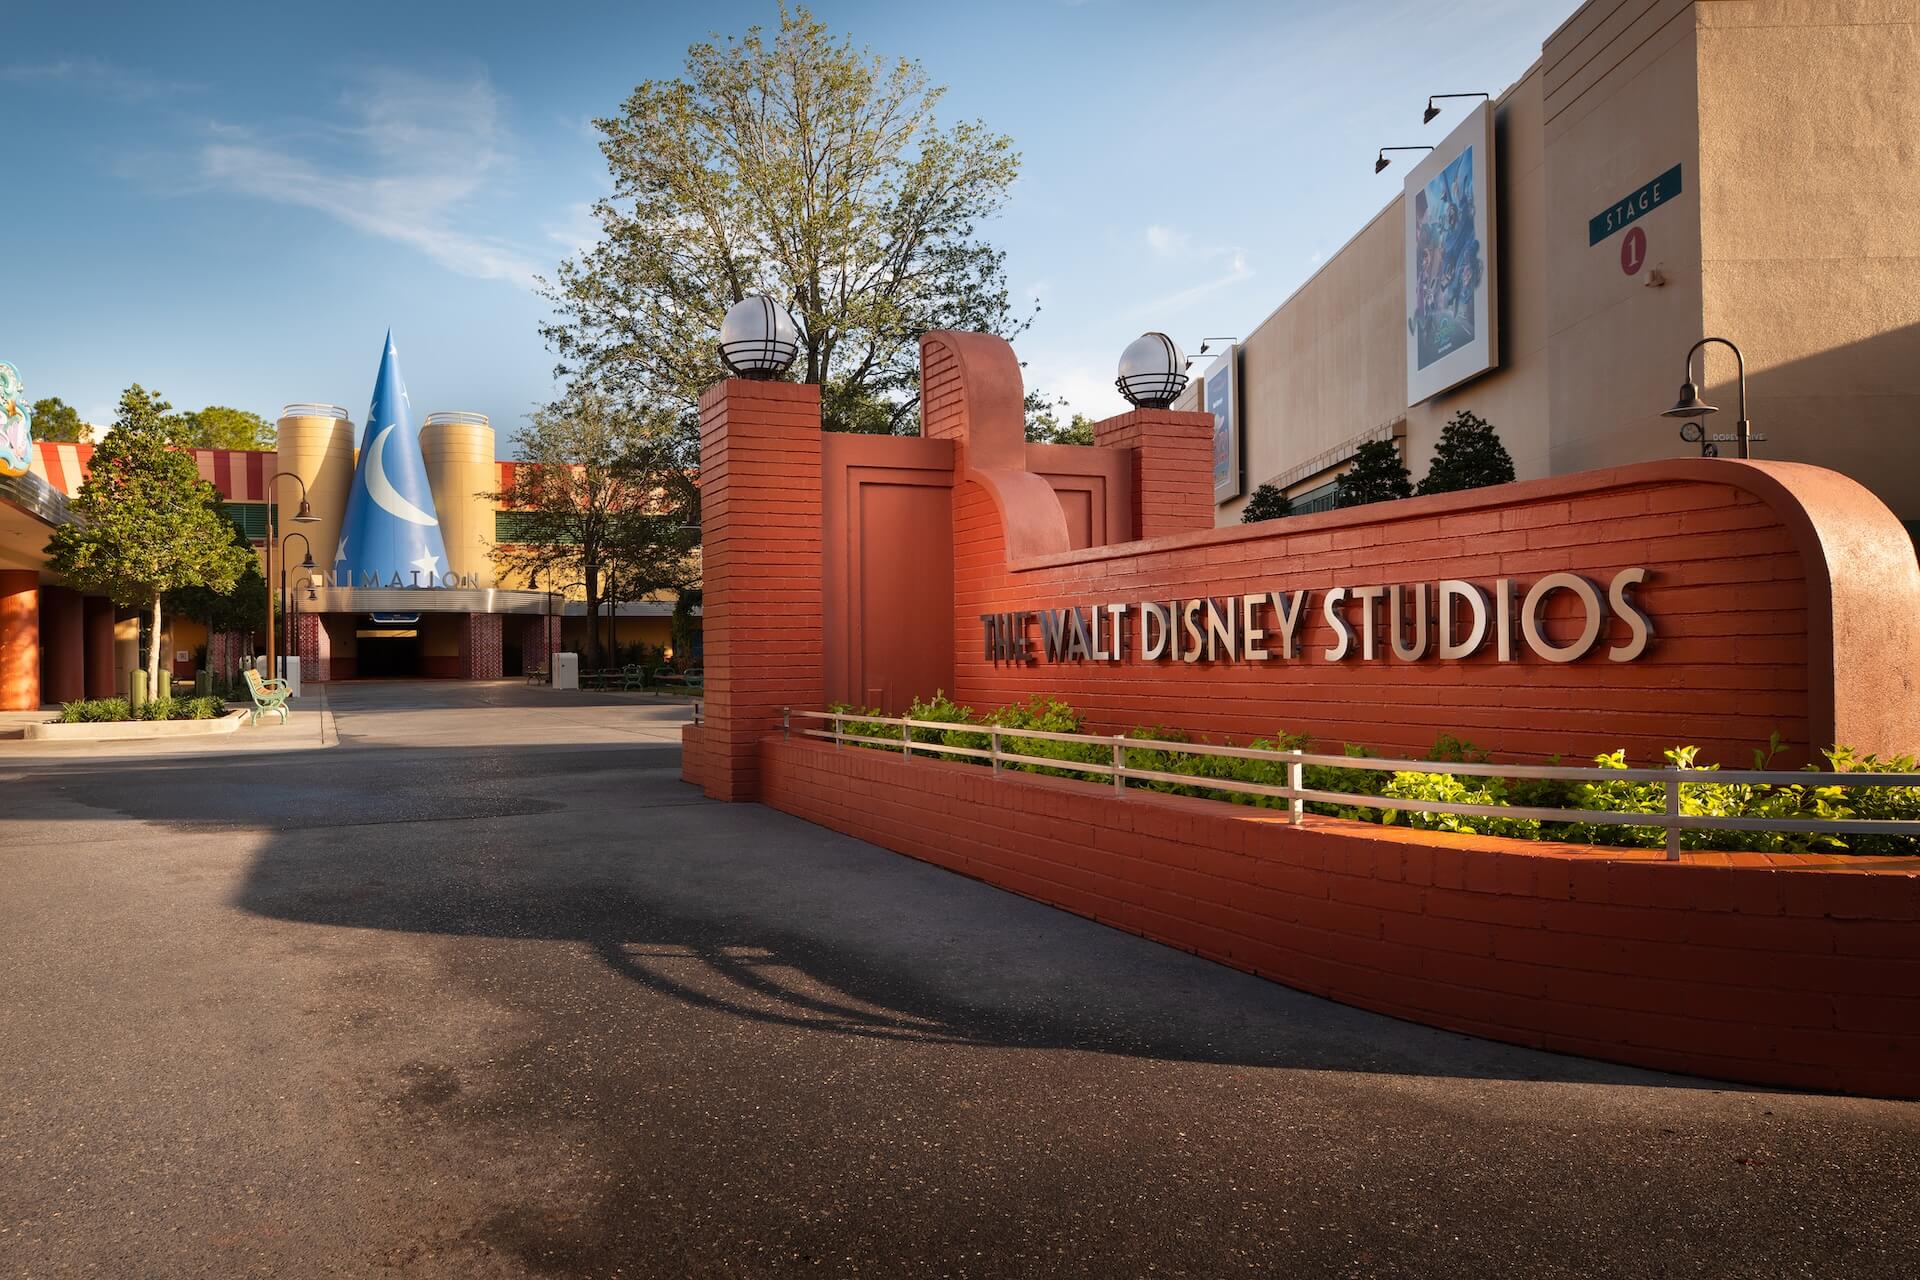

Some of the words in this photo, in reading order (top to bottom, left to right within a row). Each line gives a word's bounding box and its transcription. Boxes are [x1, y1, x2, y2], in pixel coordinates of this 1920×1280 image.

[1606, 183, 1661, 231] STAGE
[1628, 235, 1639, 266] 1
[981, 611, 1034, 661] THE
[1039, 603, 1127, 662] WALT
[1141, 590, 1305, 663] DISNEY
[1323, 567, 1648, 663] STUDIOS
